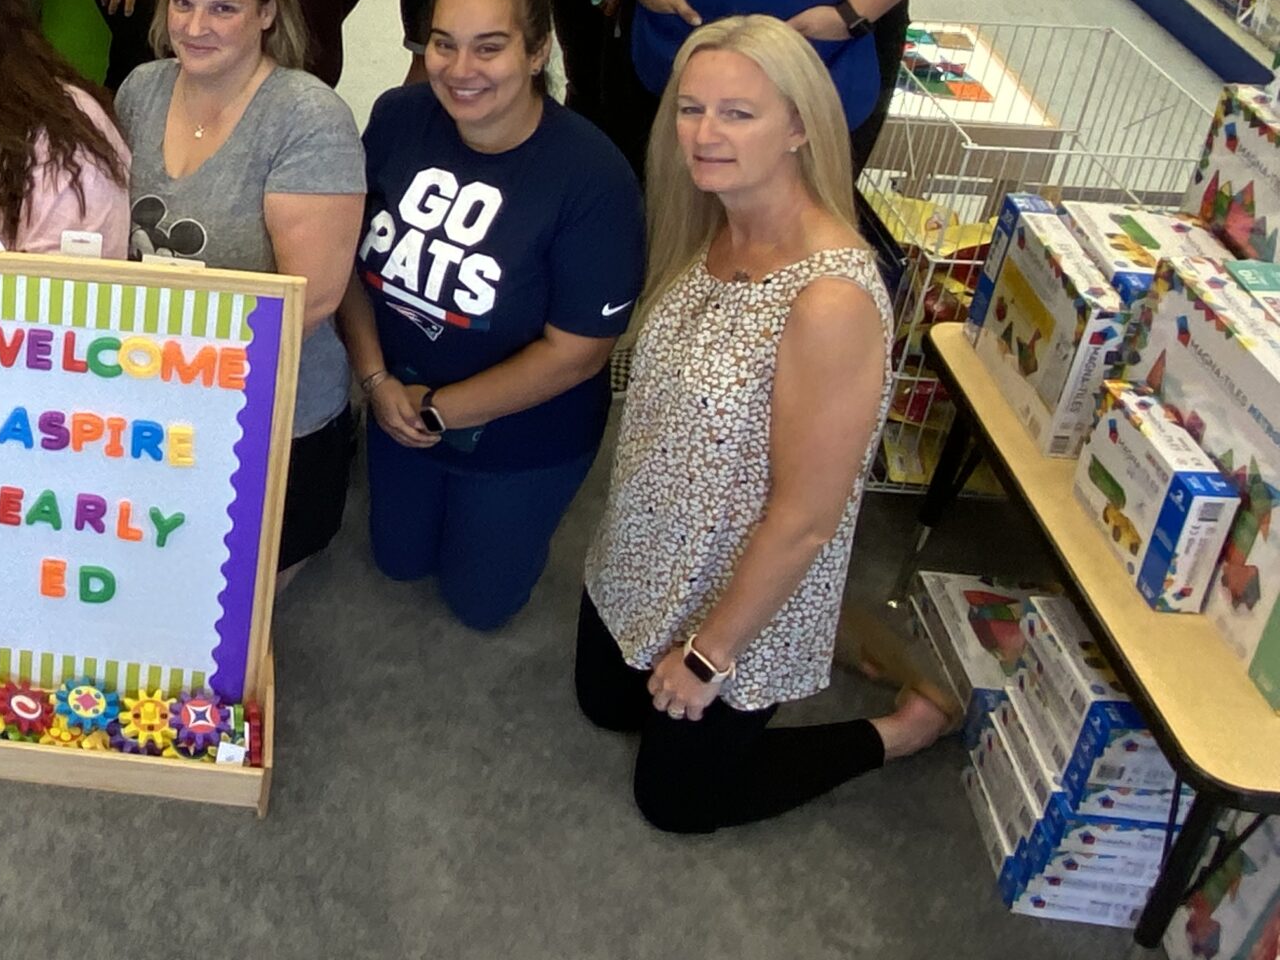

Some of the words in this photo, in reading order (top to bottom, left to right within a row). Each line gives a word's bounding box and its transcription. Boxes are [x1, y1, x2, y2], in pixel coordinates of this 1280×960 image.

[399, 167, 503, 247] GO
[359, 210, 502, 316] PATS
[1070, 346, 1100, 413] MAGNA-TILES
[1191, 341, 1248, 407] MAGNA-TILES
[40, 558, 117, 603] ED
